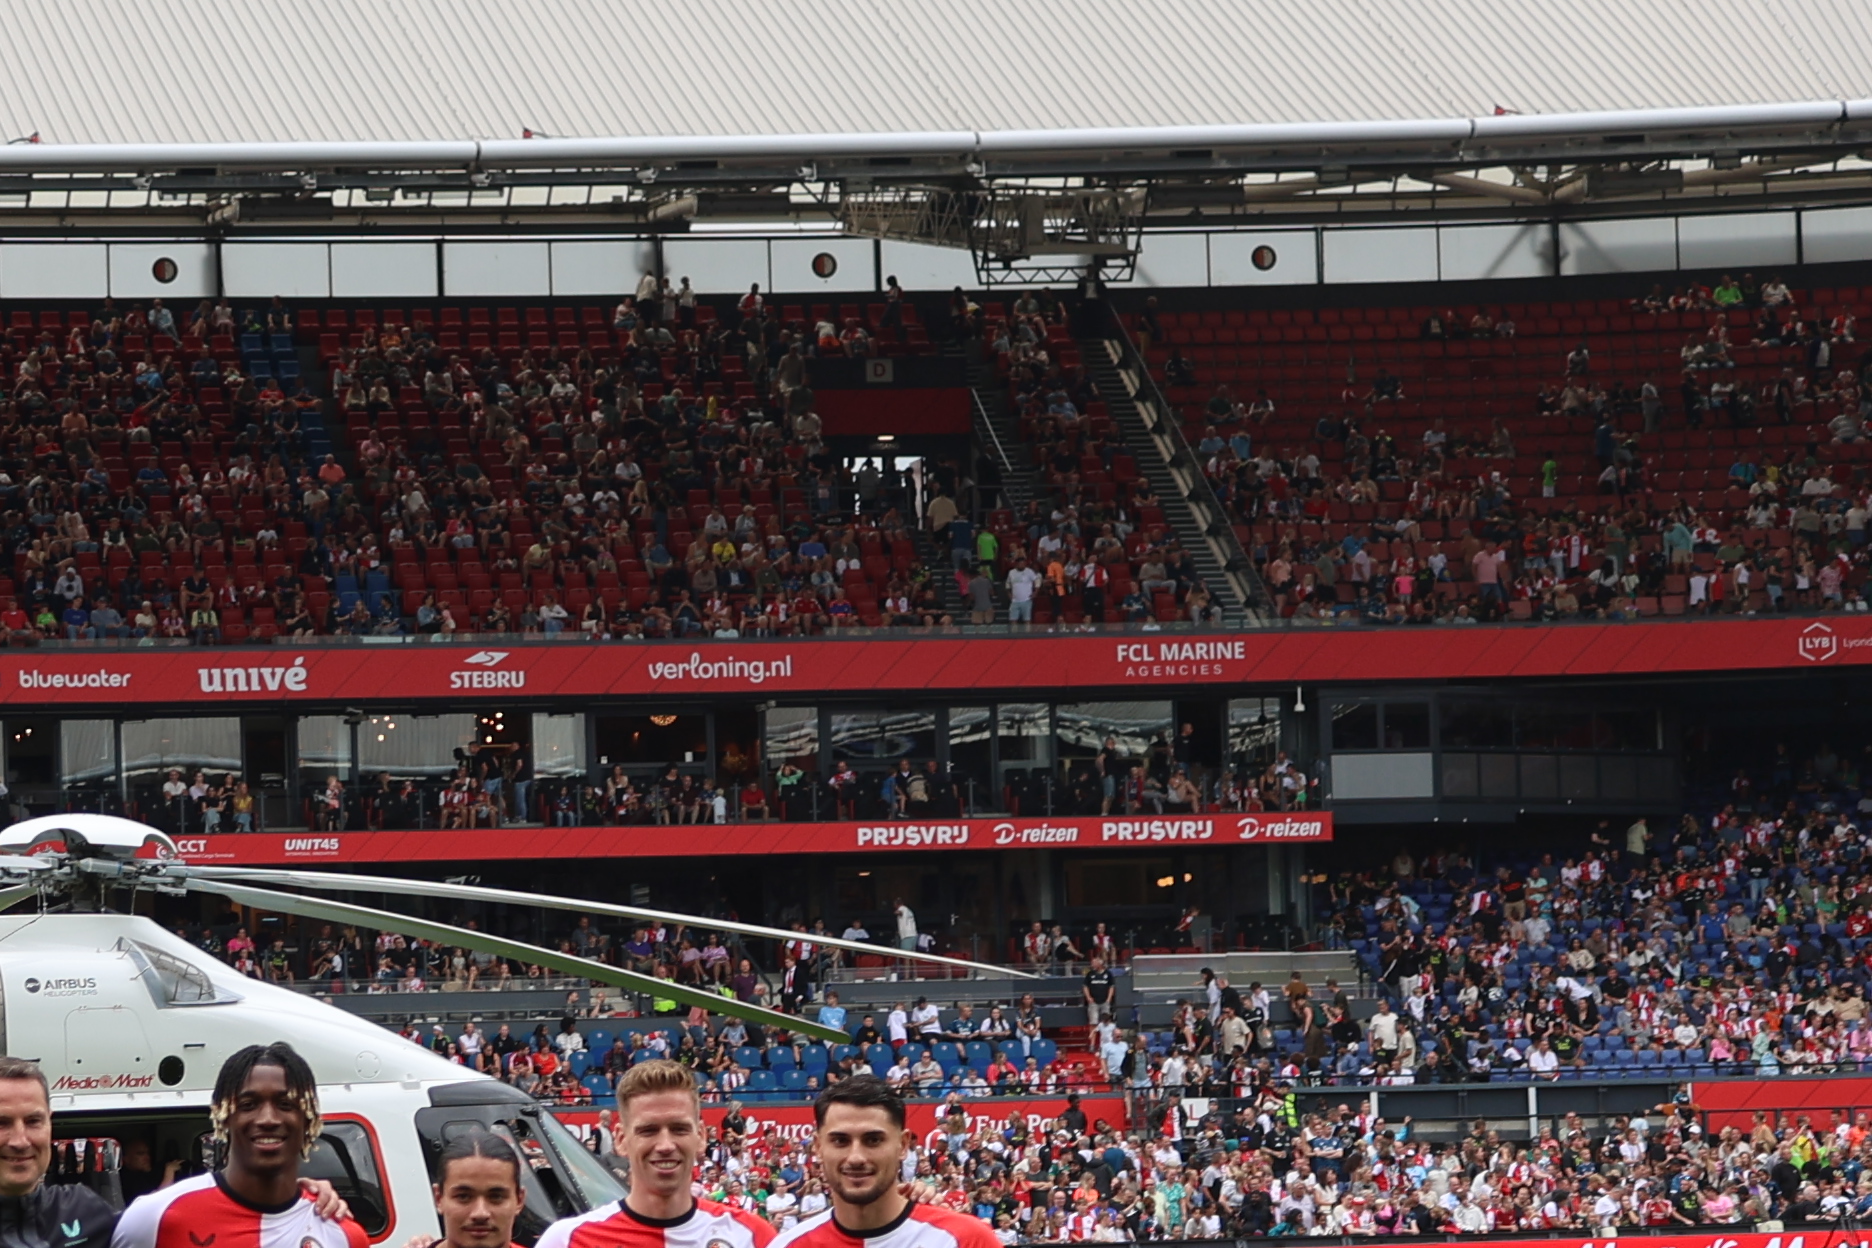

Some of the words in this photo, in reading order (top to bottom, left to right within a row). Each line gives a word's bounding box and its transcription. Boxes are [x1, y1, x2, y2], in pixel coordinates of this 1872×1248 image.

[873, 362, 886, 377] D
[1805, 636, 1830, 649] LYB
[1117, 643, 1155, 662] FCL
[1160, 641, 1246, 661] MARINE
[197, 656, 308, 692] univé
[648, 652, 792, 683] verloning.nl
[1125, 664, 1224, 677] AGENCIES
[19, 669, 132, 688] bluewater
[450, 671, 525, 688] STEBRU
[176, 840, 207, 853] CCT
[284, 838, 340, 851] UNIT45
[44, 977, 97, 990] AIRBUS
[43, 988, 98, 998] HELICOPTERS
[50, 1075, 99, 1091] Media
[110, 1074, 154, 1089] Markt
